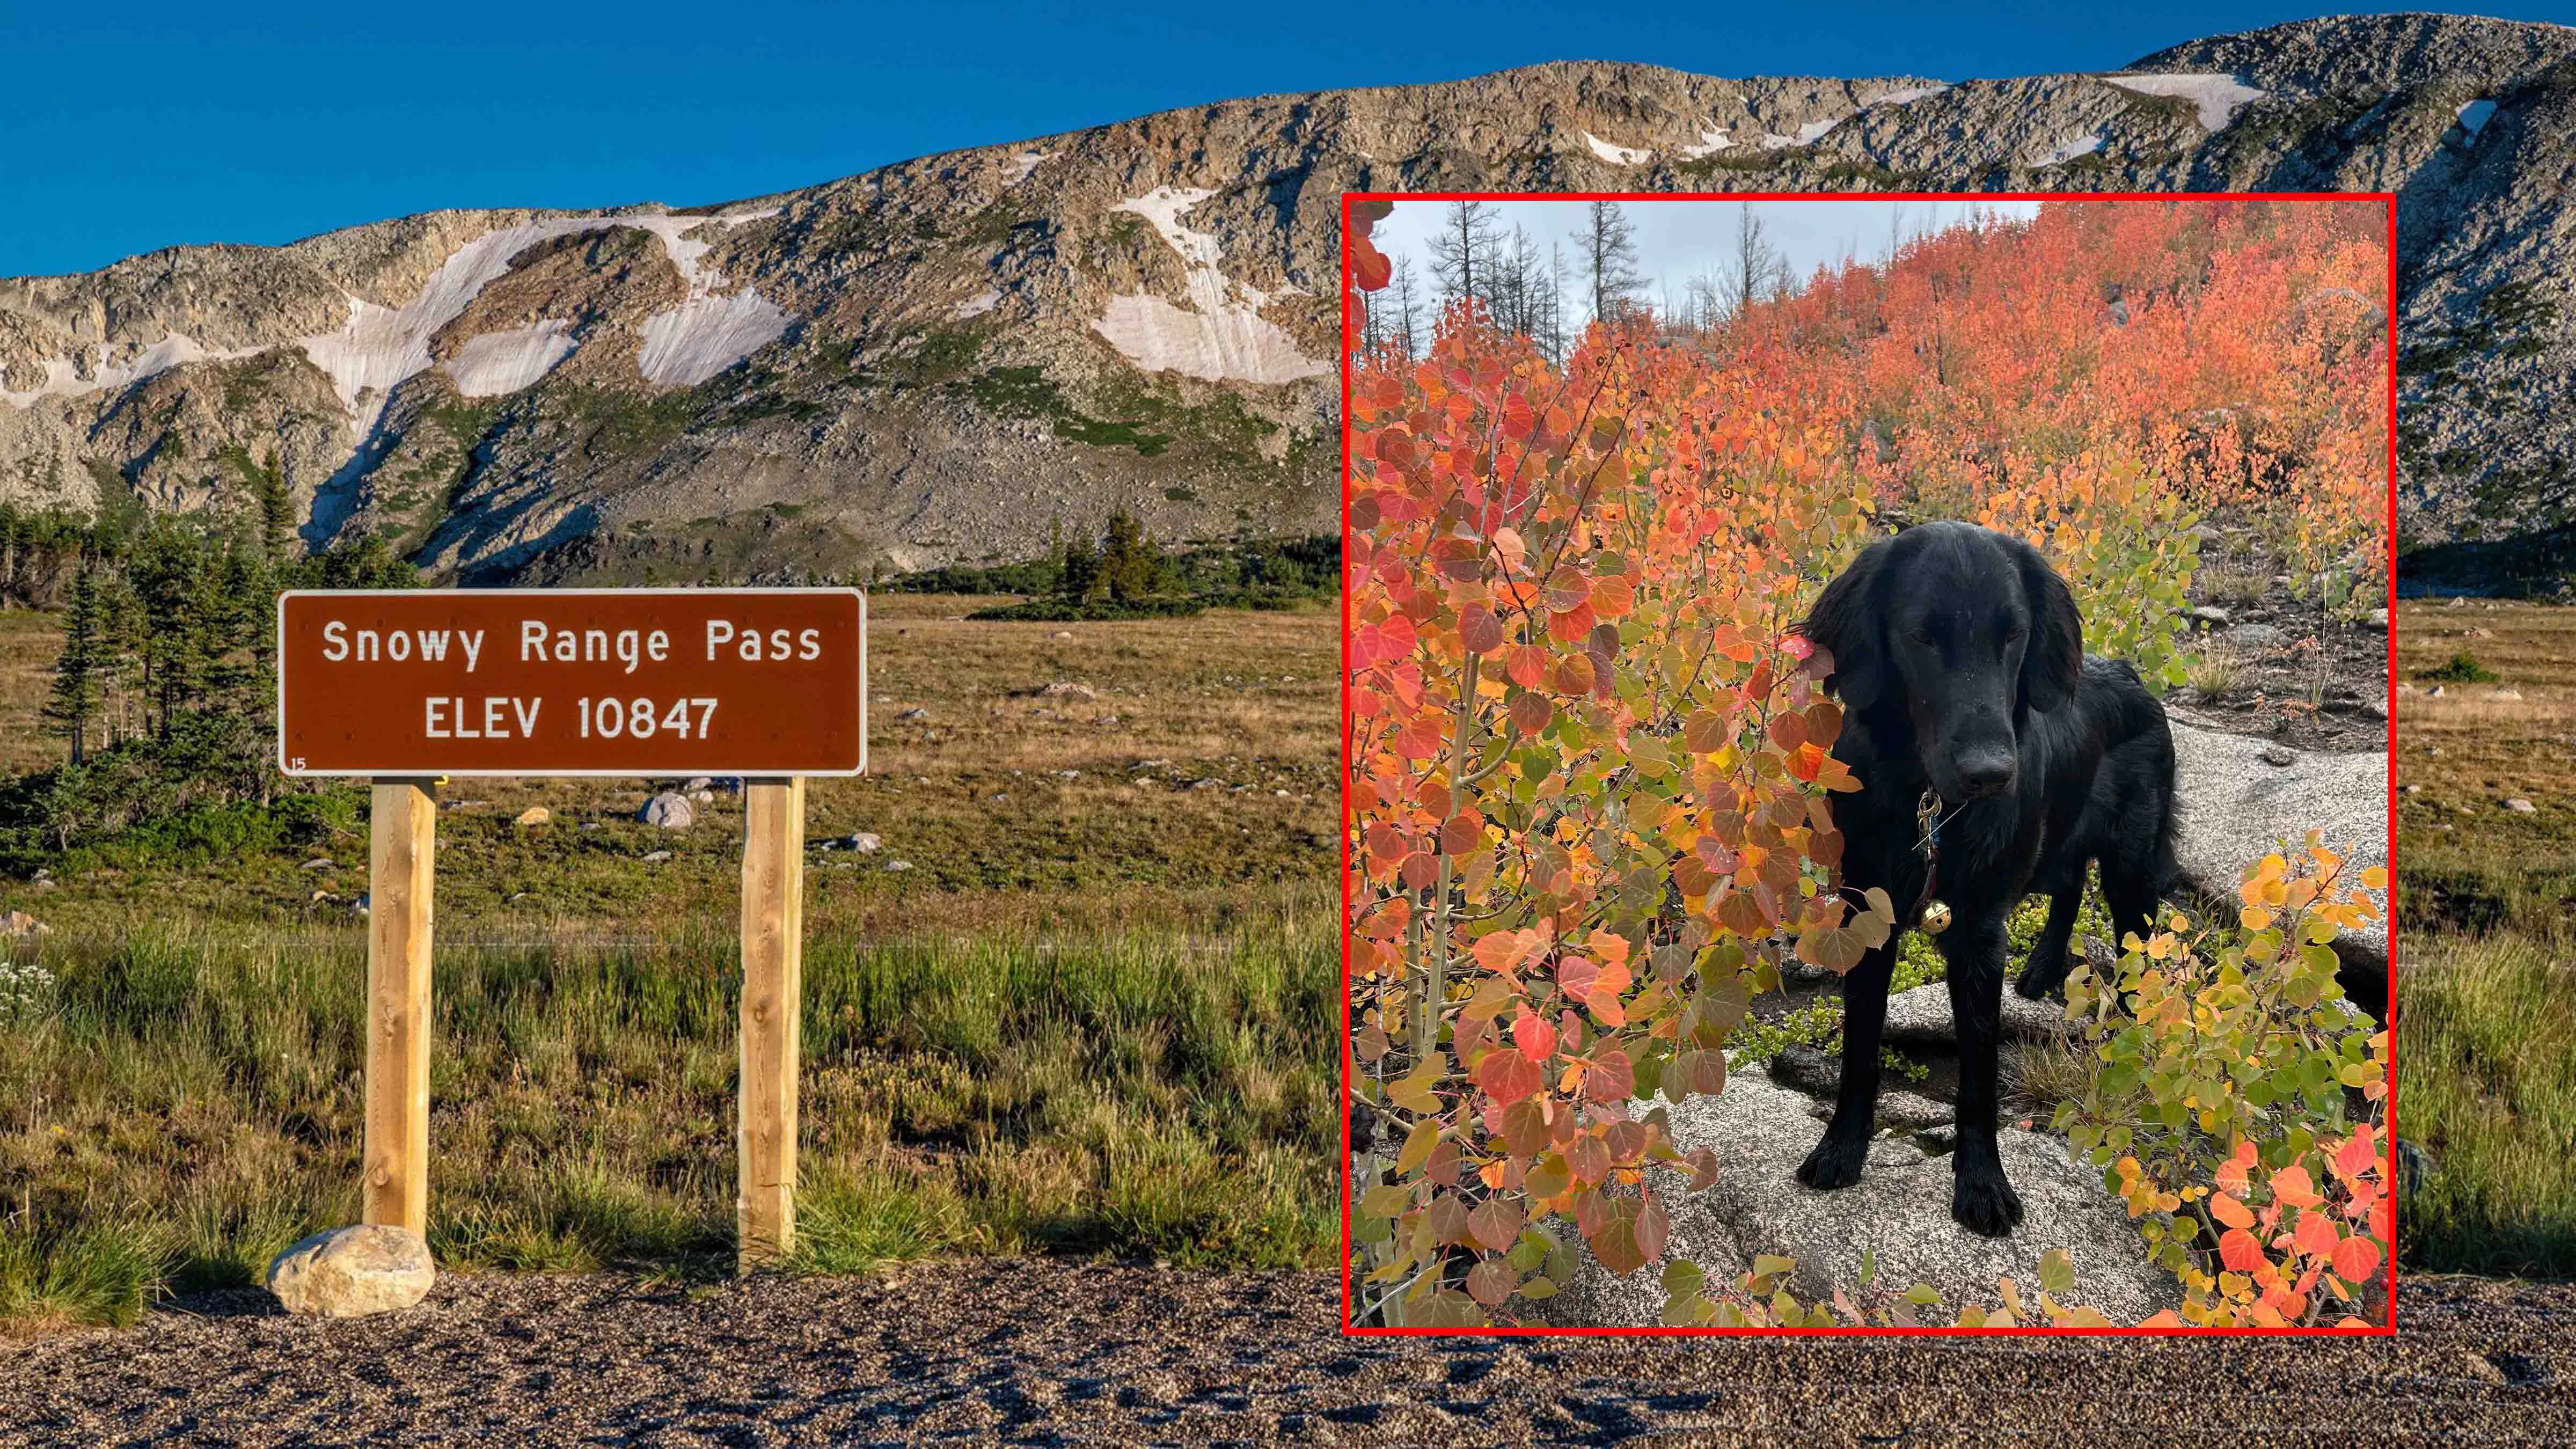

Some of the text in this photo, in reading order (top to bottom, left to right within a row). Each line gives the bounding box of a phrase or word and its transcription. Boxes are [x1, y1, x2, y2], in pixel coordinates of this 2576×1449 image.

[323, 619, 821, 675] Snowy Range Pass
[426, 697, 718, 740] ELEV 10847
[291, 757, 306, 771] 15
